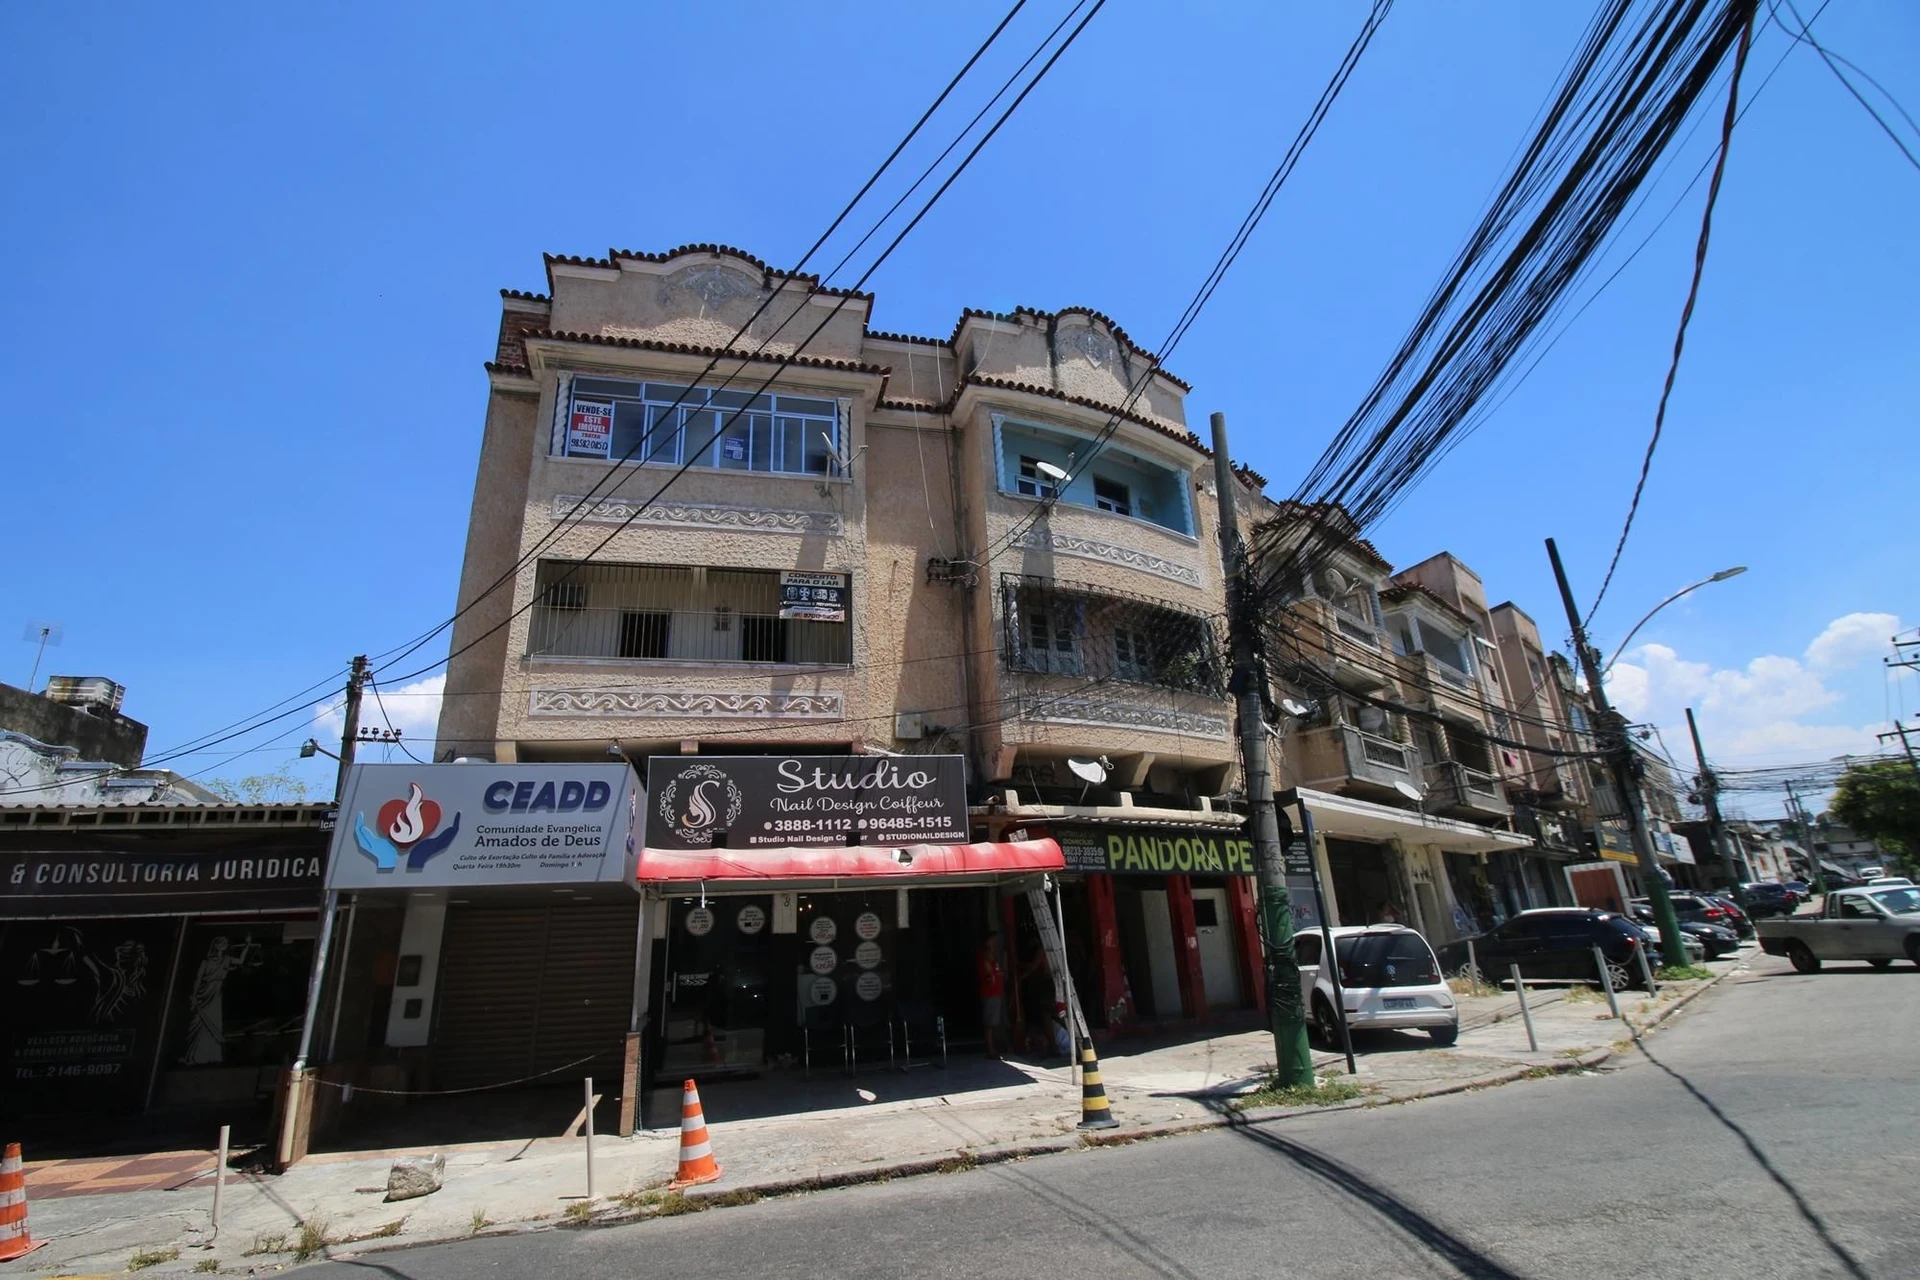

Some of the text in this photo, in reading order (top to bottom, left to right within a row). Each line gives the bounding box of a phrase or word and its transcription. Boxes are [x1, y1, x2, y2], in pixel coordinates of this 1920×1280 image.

[576, 404, 612, 416] VENDE-SE
[584, 415, 602, 424] ESTE
[777, 759, 937, 793] Studio
[483, 780, 611, 812] CEADD
[770, 795, 944, 815] Nail Design Coiffeur
[476, 824, 602, 834] Comunidade Evangelica
[774, 816, 952, 831] 3888-1112 96485-1515
[474, 834, 601, 848] Amados de Deus
[758, 835, 785, 843] Studio
[806, 835, 834, 844] Design
[885, 831, 965, 841] STUDIONAILDESIGN
[1107, 835, 1254, 873] PANDORA PE
[10, 857, 321, 884] & CONSULTORIA JURIDICA
